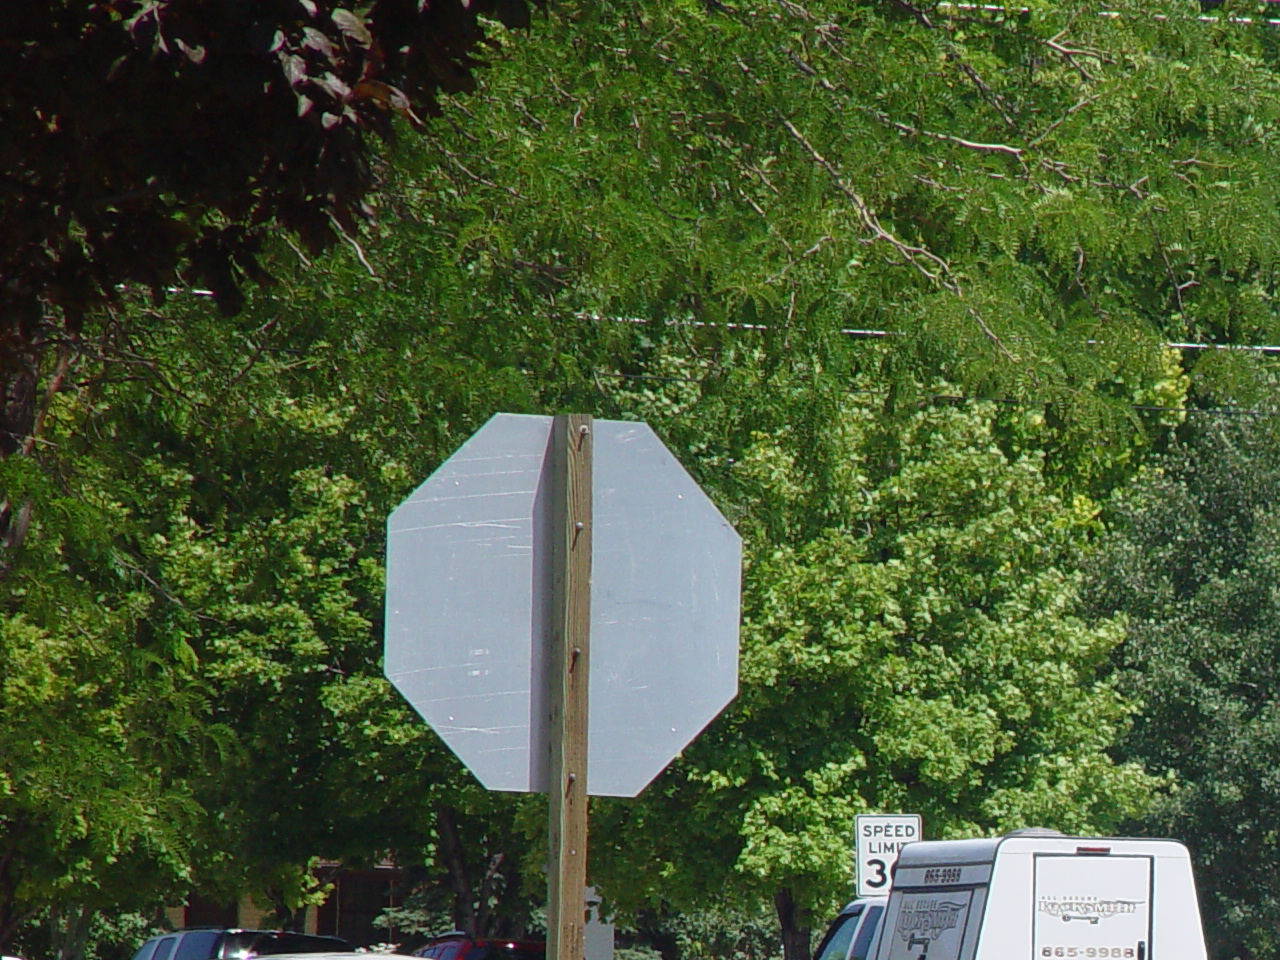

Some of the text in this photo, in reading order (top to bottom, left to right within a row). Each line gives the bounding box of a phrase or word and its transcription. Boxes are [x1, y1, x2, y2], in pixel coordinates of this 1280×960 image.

[863, 824, 915, 838] SPEED
[868, 841, 907, 854] LIMI
[865, 858, 897, 888] 3
